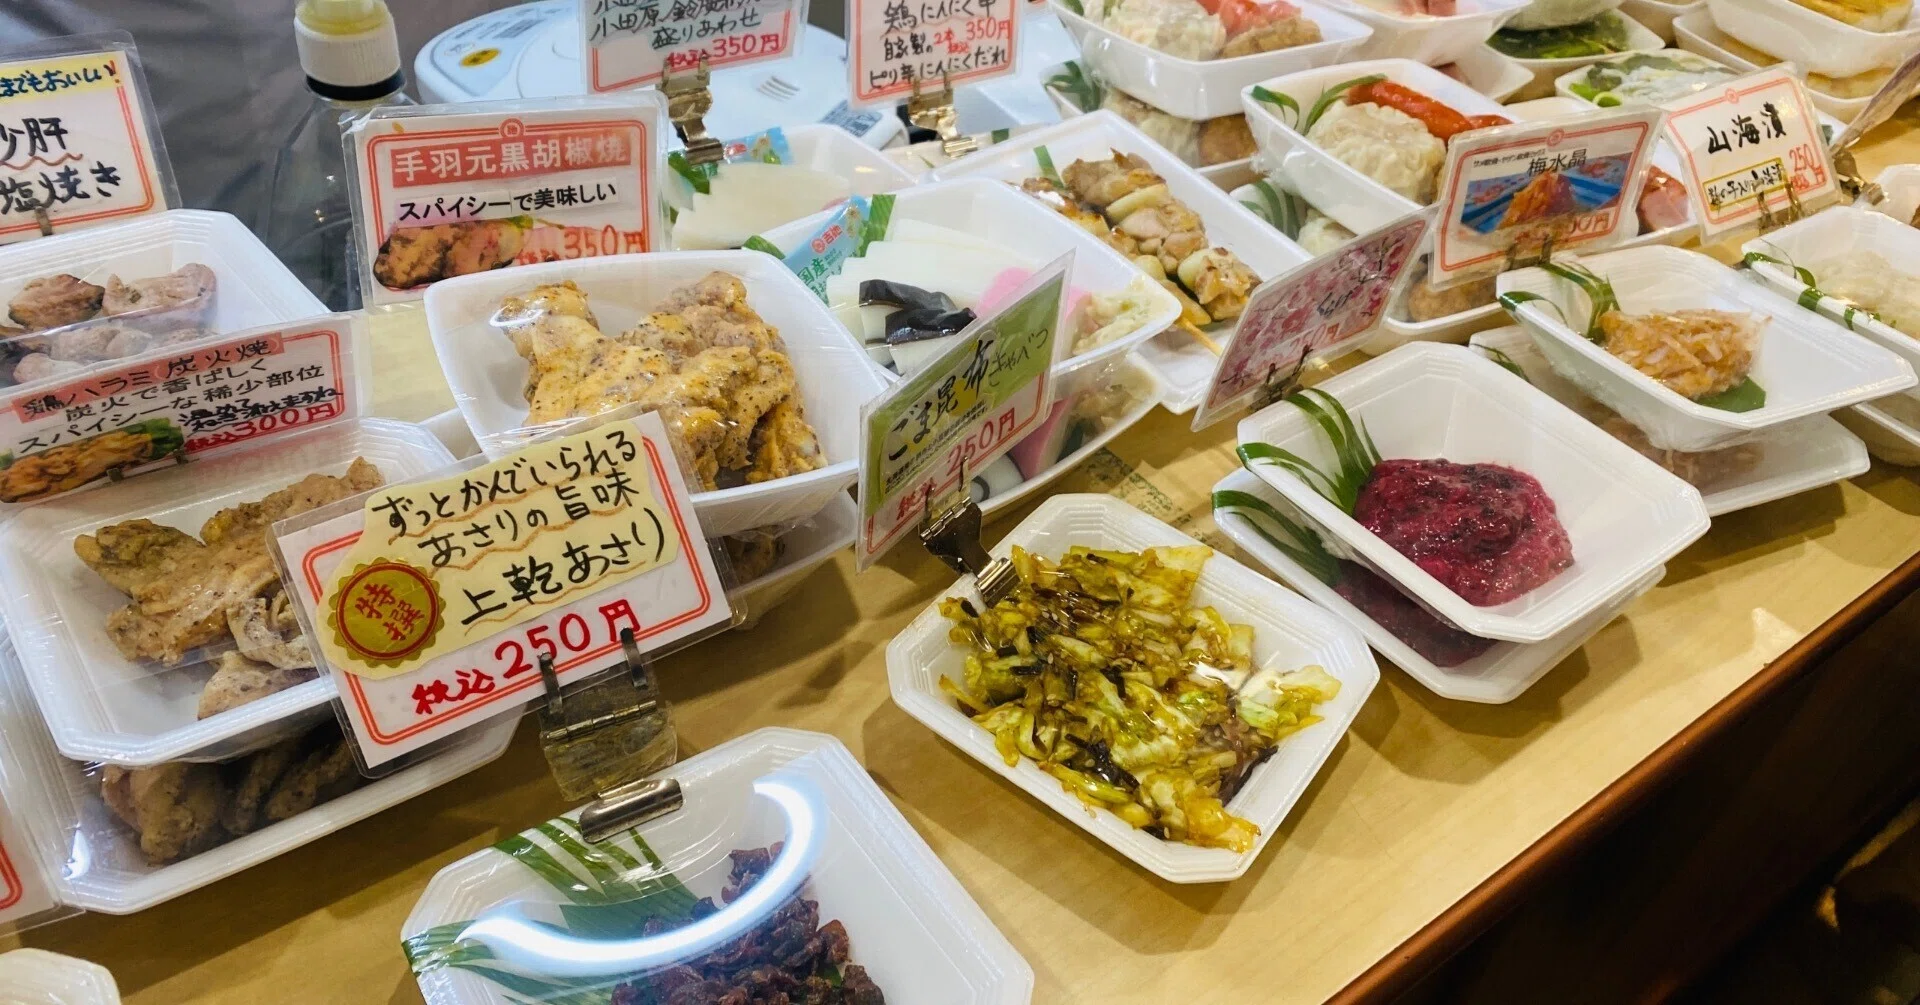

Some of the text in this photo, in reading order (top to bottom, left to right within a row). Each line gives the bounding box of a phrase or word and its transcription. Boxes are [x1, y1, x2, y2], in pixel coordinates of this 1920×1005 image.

[651, 8, 761, 49] 盛りあわせ
[869, 45, 1008, 89] ピリ辛にんにくだれ
[394, 133, 631, 183] 手羽元黒胡椒焼
[1527, 148, 1587, 177] 梅水晶
[399, 181, 618, 222] スパイシーで美味しい
[19, 364, 325, 454] スパイシーな稀少部位
[65, 357, 267, 423] 炭火で香ばしく
[417, 466, 641, 569] あさりの旨味
[410, 598, 643, 715] 税込250円
